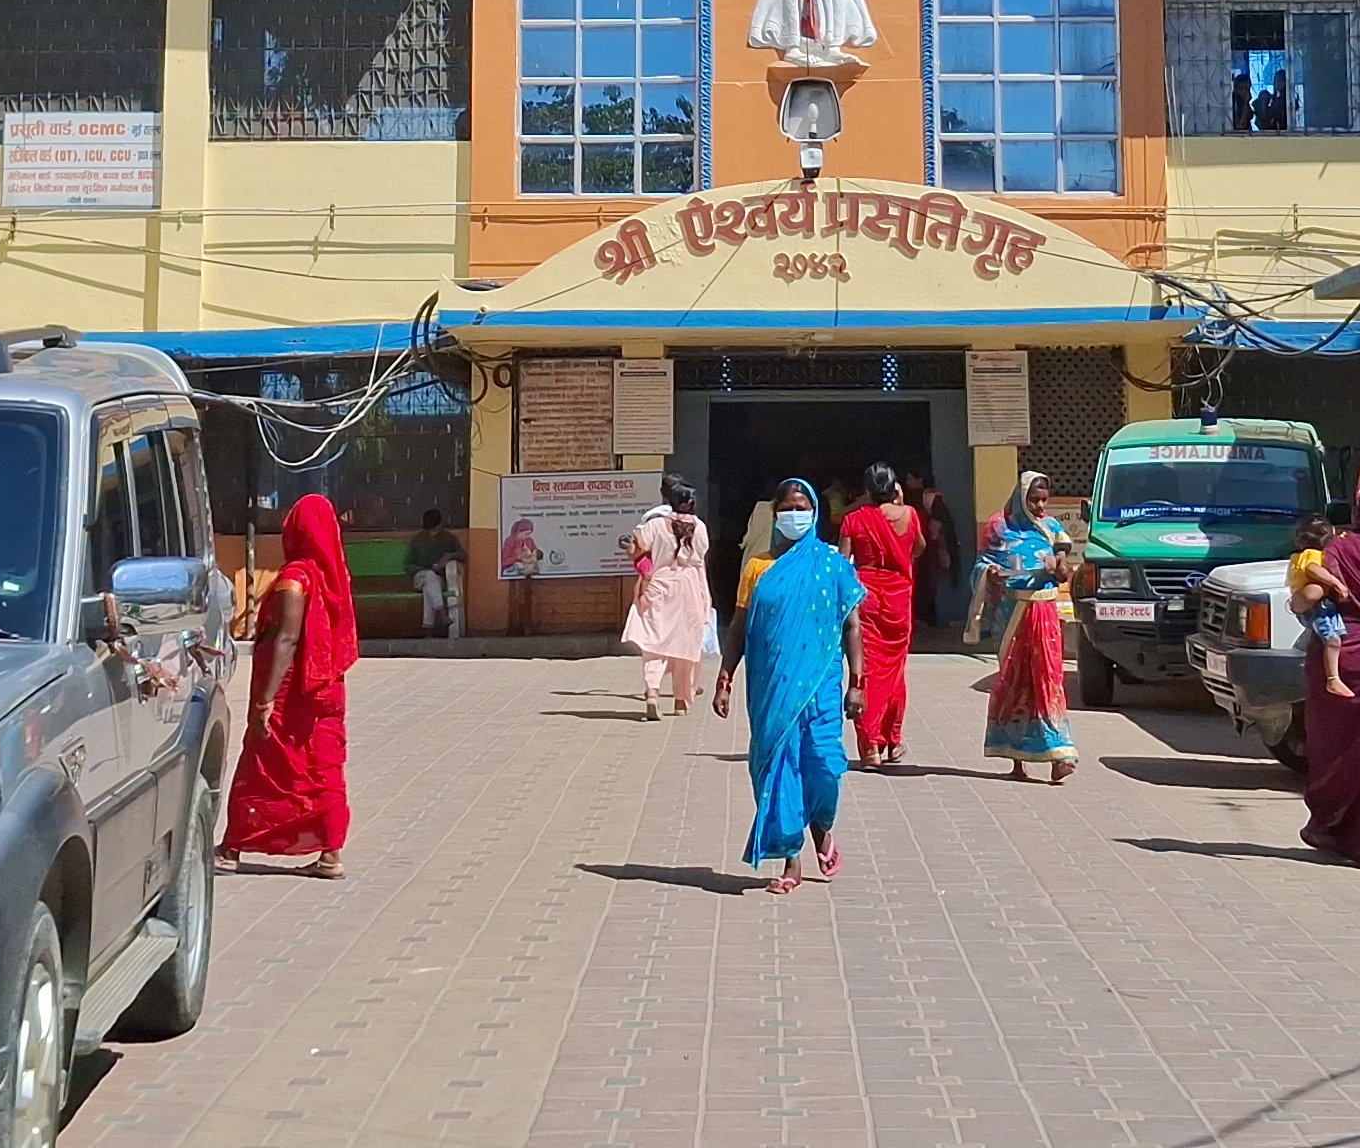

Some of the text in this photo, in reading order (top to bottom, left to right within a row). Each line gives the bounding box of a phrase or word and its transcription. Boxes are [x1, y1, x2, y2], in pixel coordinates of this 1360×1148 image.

[79, 123, 126, 135] OCMC
[85, 149, 106, 163] ICU,
[110, 149, 132, 162] CCU
[594, 218, 658, 284] श्री
[675, 180, 818, 257] ऐश्वर्य
[963, 210, 1046, 280] गृह
[773, 251, 851, 284] २०४२
